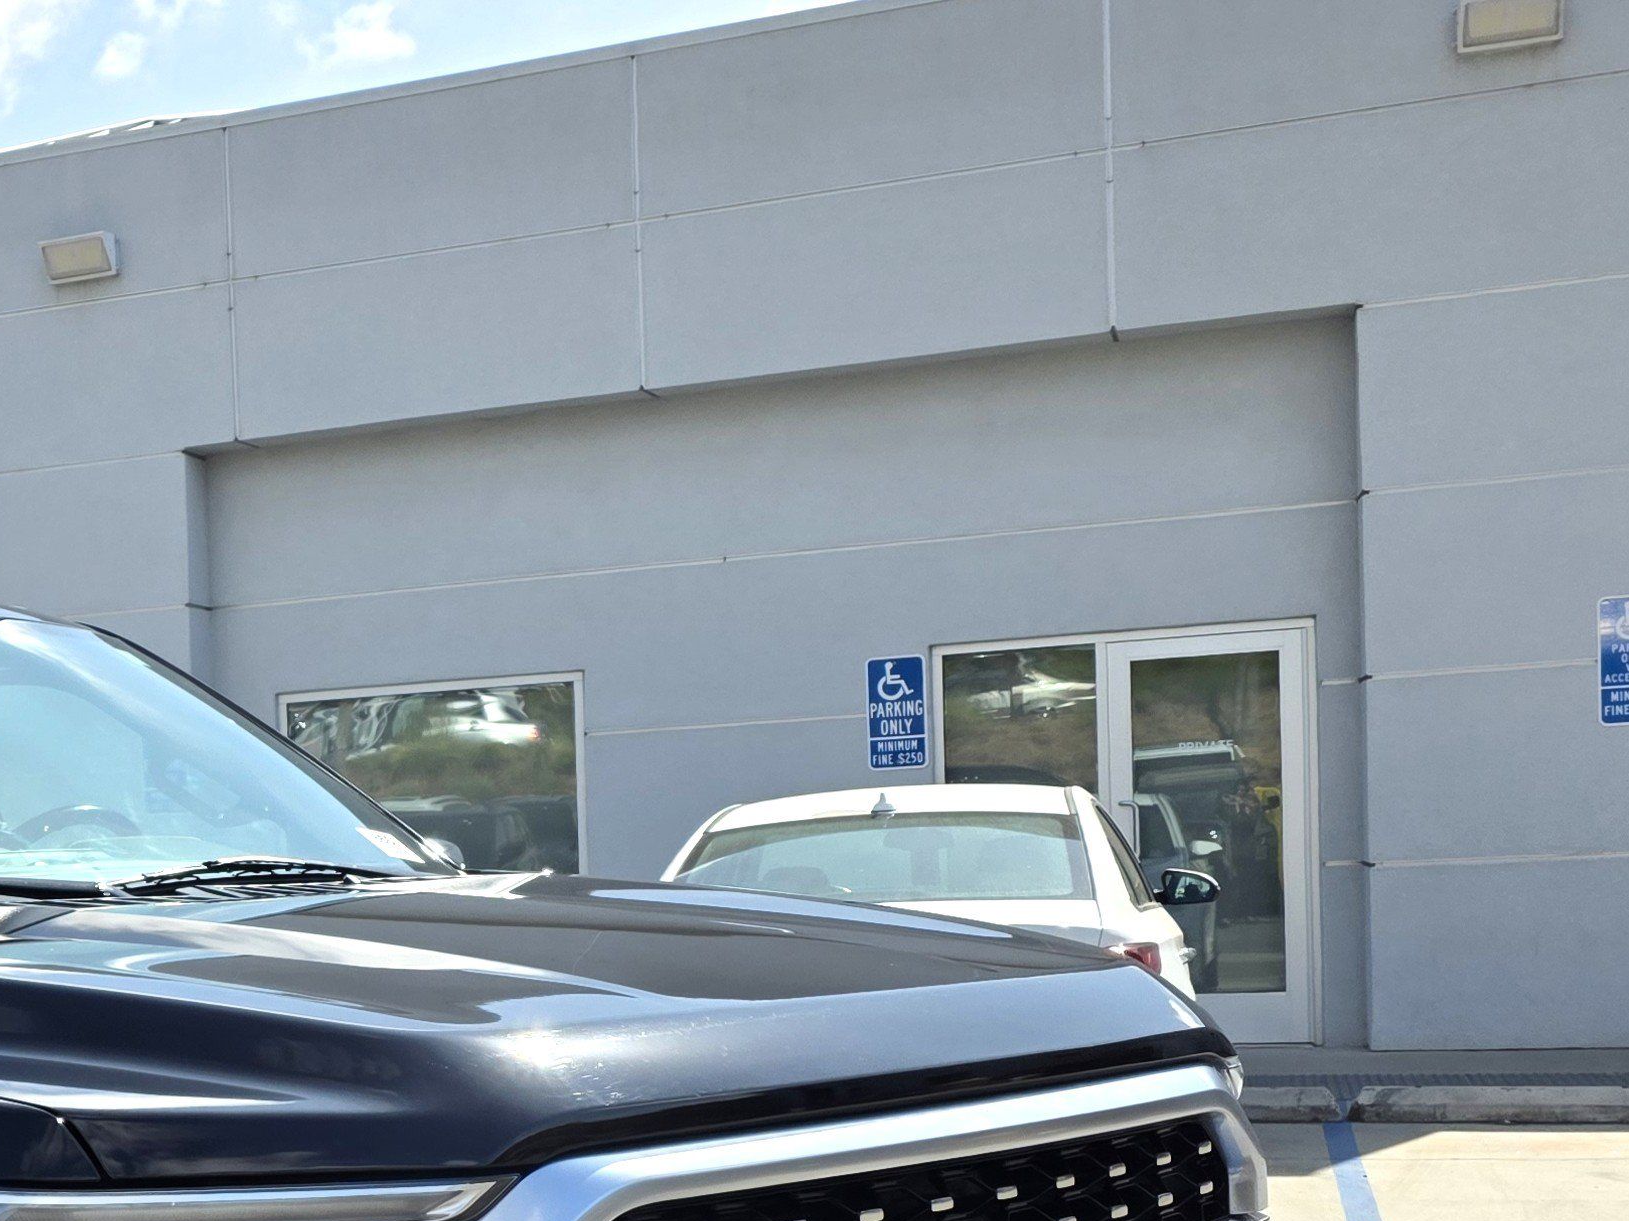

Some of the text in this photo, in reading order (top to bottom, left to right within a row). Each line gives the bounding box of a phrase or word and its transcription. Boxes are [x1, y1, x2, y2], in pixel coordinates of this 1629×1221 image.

[869, 700, 923, 718] PARKING
[880, 719, 913, 736] ONLY
[877, 739, 918, 752] MINIMUM
[872, 752, 923, 765] FINE $250
